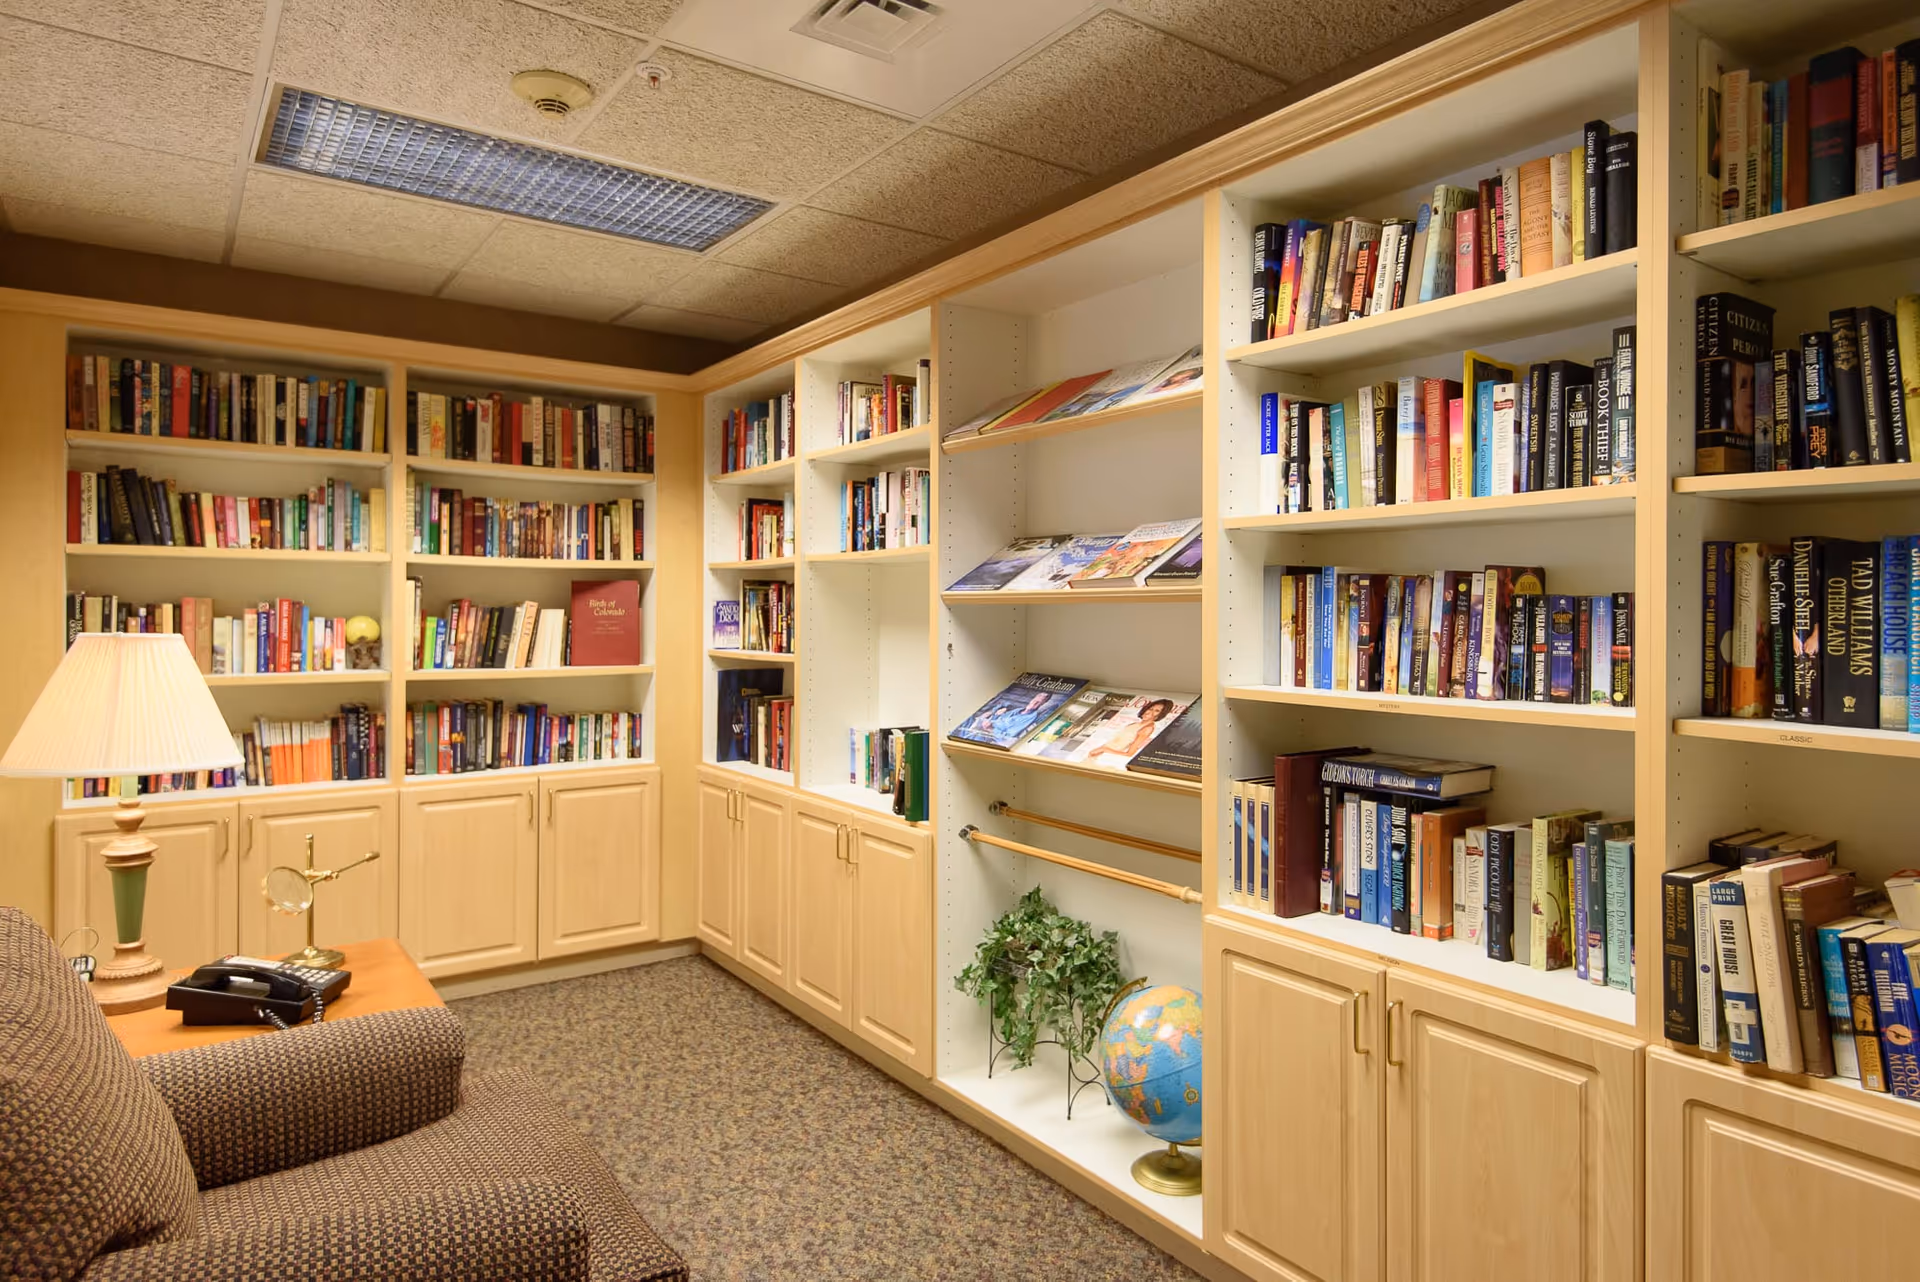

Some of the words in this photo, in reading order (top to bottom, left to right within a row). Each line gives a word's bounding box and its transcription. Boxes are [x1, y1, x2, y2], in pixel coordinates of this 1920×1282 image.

[1587, 131, 1596, 155] Stone
[1586, 157, 1596, 174] Boy
[1503, 176, 1512, 202] Norah
[1589, 187, 1597, 208] RONALD
[1495, 186, 1503, 217] MORTAL
[1503, 203, 1512, 224] Lofts
[1524, 215, 1548, 226] AGONY
[1589, 209, 1597, 234] LEVITSKY
[1254, 230, 1265, 248] DEAN
[1286, 228, 1294, 244] DEAN
[1523, 231, 1549, 242] ECSTASY
[1284, 245, 1292, 267] KOONTZ
[1398, 235, 1408, 263] PARIS
[1253, 251, 1264, 274] KOONTZ
[1395, 264, 1404, 282] ONE
[1252, 287, 1265, 306] COLD
[1350, 275, 1367, 311] ENGAGEMENT
[1252, 305, 1265, 322] FIRE
[1697, 306, 1706, 351] PEROT
[1709, 296, 1719, 357] CITIZEN
[1860, 320, 1870, 336] THIS
[1804, 346, 1818, 364] JOHN
[1861, 335, 1871, 352] YEAR
[1620, 348, 1632, 368] FATAL
[1774, 352, 1787, 371] THE
[1863, 360, 1872, 376] WILL
[1886, 348, 1898, 386] MONEY
[1619, 369, 1632, 396] VOYAGE
[1703, 361, 1711, 392] GERALD
[1805, 364, 1820, 401] SANDFORD
[1549, 371, 1561, 410] PARADISE
[1597, 379, 1609, 419] BOOK
[1775, 372, 1789, 421] VIRGINIAN
[1865, 384, 1876, 417] DIFFERENT
[1549, 412, 1559, 433] LOST
[1569, 411, 1588, 419] SCOTT
[1569, 418, 1589, 428] TUROW
[1889, 389, 1904, 446] MOUNTAIN
[1498, 411, 1510, 450] SANDRA
[1530, 414, 1539, 453] SWEETSIR
[1573, 427, 1584, 438] THE
[1597, 419, 1609, 461] THIEF
[1807, 425, 1820, 460] PREY
[1819, 427, 1827, 456] STOLEN
[1480, 444, 1488, 463] Gena
[1573, 439, 1584, 453] LAWS
[1707, 544, 1717, 569] STEPHEN
[1793, 540, 1813, 597] DANIELLE
[1770, 558, 1784, 582] Sue
[1850, 557, 1874, 590] TAD
[1883, 552, 1907, 601] BEACH
[1707, 571, 1716, 596] COLBERT
[589, 598, 607, 608] Birds
[608, 599, 616, 608] of
[1359, 588, 1367, 618] JOURNEY
[1485, 587, 1494, 609] BLOOD
[1770, 581, 1786, 625] Grafton
[593, 608, 626, 616] Colorado
[1614, 609, 1628, 628] JOHN
[1706, 612, 1715, 622] AM
[1793, 597, 1815, 633] STEEL
[1827, 577, 1847, 655] OTHERLAND
[1456, 614, 1464, 639] CAROL
[1511, 622, 1519, 644] HOAG
[1517, 626, 1525, 643] TAMI
[1616, 628, 1628, 645] SAUL
[1705, 622, 1716, 646] AMERICA
[1849, 594, 1874, 676] WILLIAMS
[1882, 605, 1907, 655] HOUSE
[1455, 641, 1463, 679] GOODMAN
[1466, 640, 1475, 683] KINGSBURY
[1473, 652, 1481, 672] KAREN
[1535, 653, 1544, 661] THE
[1705, 647, 1716, 661] (AND
[1413, 656, 1422, 677] HIGGS
[1705, 662, 1715, 671] SO
[1705, 671, 1715, 681] CAN
[1804, 669, 1817, 688] Sins
[1016, 672, 1038, 688] Billy
[1036, 676, 1076, 692] Graham
[1794, 662, 1805, 696] Mother
[1779, 735, 1814, 744] CLASSIC
[1321, 761, 1352, 785] GIDEON'S
[1351, 768, 1376, 788] TORCH
[1365, 809, 1373, 841] OLIVER'S
[1391, 805, 1407, 826] JOHN
[1391, 826, 1407, 845] SAUL
[1489, 832, 1500, 854] JODI
[1365, 842, 1374, 864] STORY
[1392, 860, 1404, 880] BLACK
[1467, 857, 1480, 894] SANDRA
[1490, 857, 1500, 899] PICOULT
[1606, 863, 1614, 878] JOY
[1615, 866, 1626, 889] FROM
[1364, 873, 1373, 896] SEGAL
[1392, 880, 1404, 911] LIGHTNING
[1607, 879, 1614, 889] IN
[1711, 887, 1736, 896] LARGE
[1607, 892, 1616, 907] THE
[1616, 891, 1627, 909] THIS
[1676, 885, 1688, 931] DEADLY
[1712, 894, 1736, 904] PRINT
[1615, 909, 1627, 927] DAY
[1665, 884, 1677, 939] MEDICINE
[1606, 907, 1615, 945] MORNING
[1719, 919, 1736, 946] GREAT
[1616, 928, 1627, 965] FORWARD
[1795, 933, 1804, 967] WORLD'S
[1723, 947, 1740, 976] HOUSE
[1798, 967, 1810, 1007] RELIGIONS
[1848, 958, 1856, 993] SIEGEL
[1856, 960, 1868, 993] BARRY
[1873, 969, 1895, 1012] KELLERMAN
[1890, 982, 1909, 1001] FAYE
[1888, 1052, 1909, 1097] MUSIC
[1902, 1052, 1920, 1098] MOON
